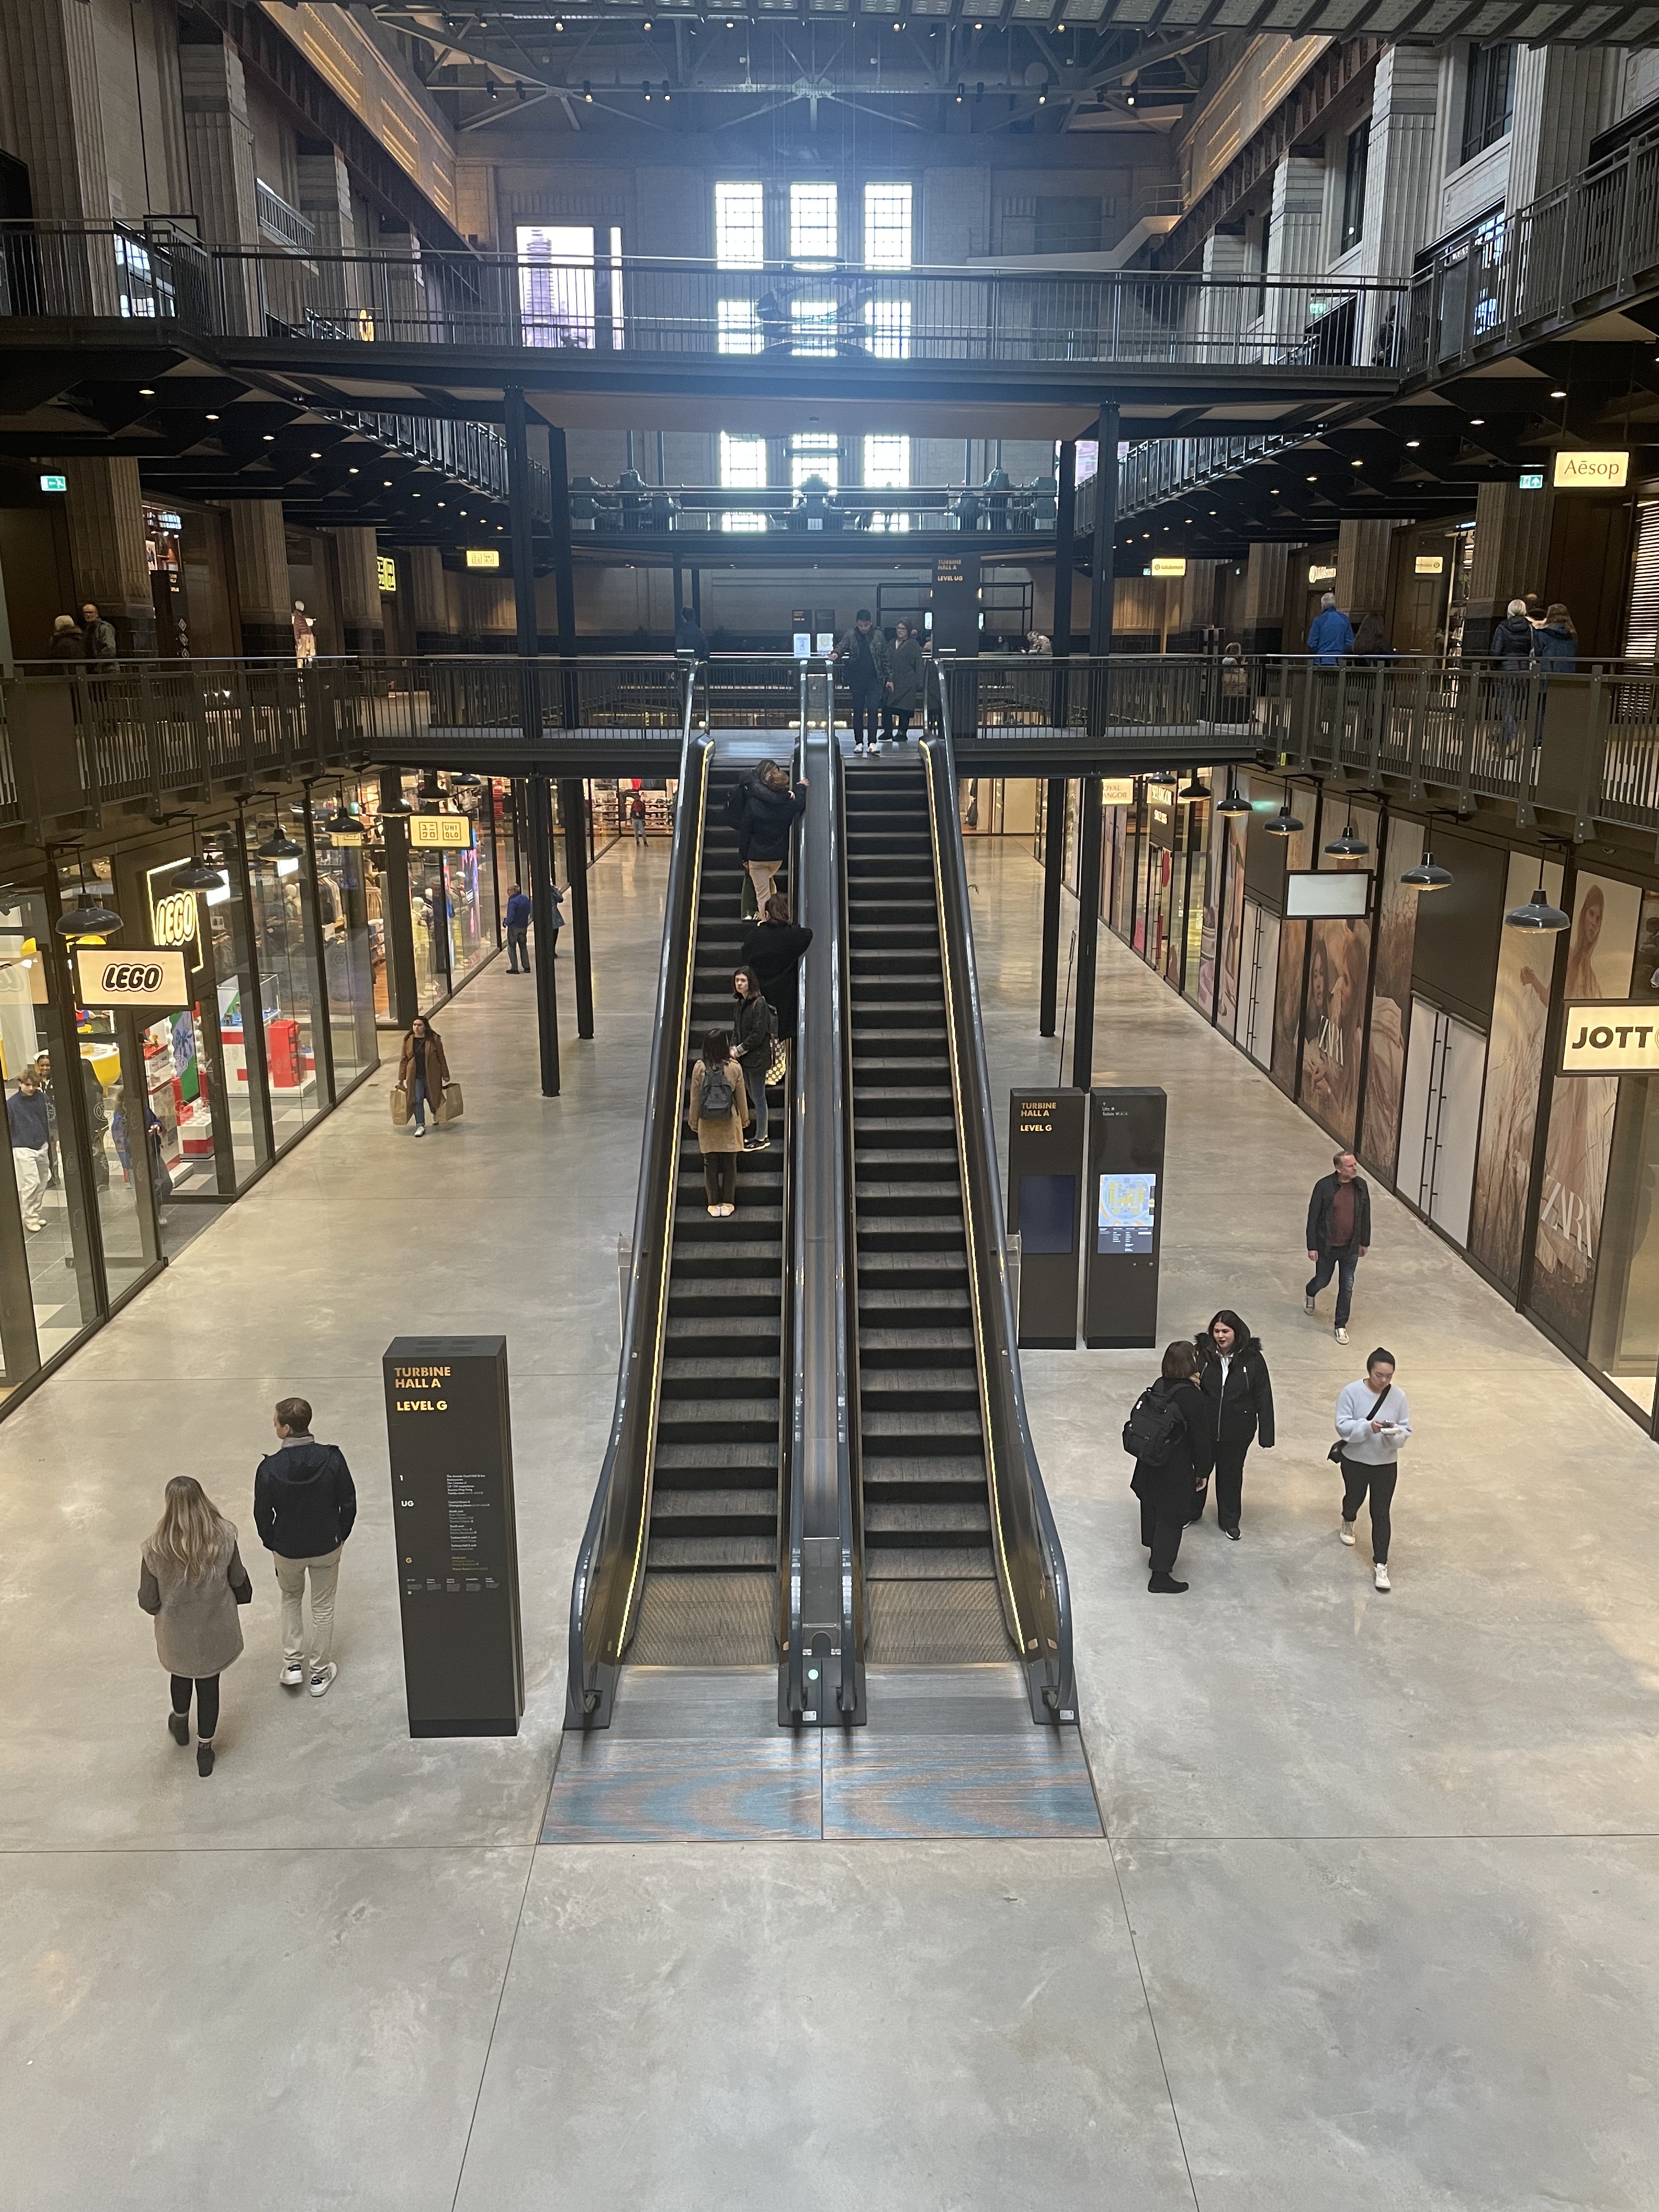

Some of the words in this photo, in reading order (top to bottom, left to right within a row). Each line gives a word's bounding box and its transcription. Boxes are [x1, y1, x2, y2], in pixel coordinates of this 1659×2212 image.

[1564, 460, 1619, 479] Aēsop
[157, 893, 194, 946] LEGO
[104, 966, 161, 990] LEGO
[1318, 1015, 1344, 1066] ZARA
[1572, 1026, 1654, 1049] JOTT
[1541, 1175, 1595, 1261] ZARA
[394, 1367, 451, 1377] TURBINE
[395, 1378, 428, 1388] HALL
[431, 1378, 441, 1388] A
[397, 1401, 435, 1411] LEVEL
[436, 1400, 448, 1410] G
